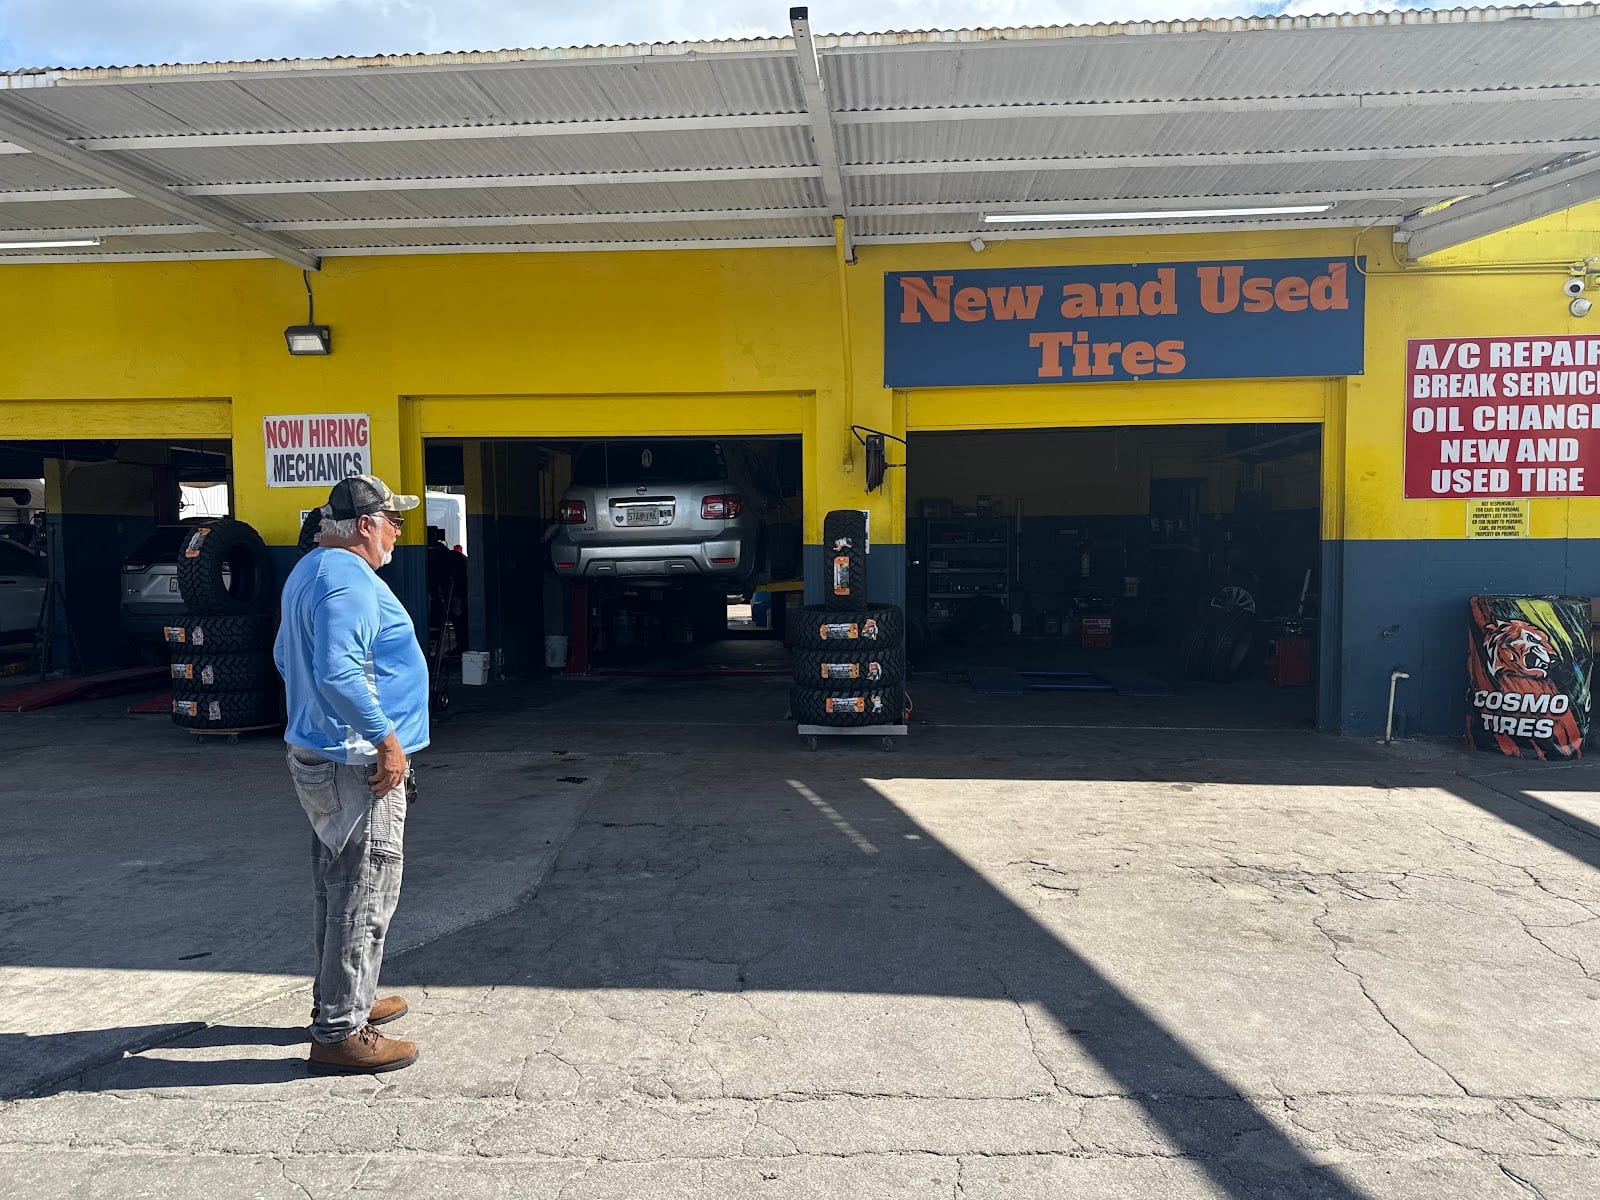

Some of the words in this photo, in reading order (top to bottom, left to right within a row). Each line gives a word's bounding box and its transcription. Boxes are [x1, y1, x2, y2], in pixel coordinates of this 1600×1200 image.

[900, 276, 1043, 323] New
[1061, 268, 1178, 318] and
[1197, 263, 1349, 313] Used
[1029, 331, 1186, 377] Tires
[1416, 343, 1481, 369] A/C
[1413, 373, 1497, 398] BREAK
[1503, 371, 1600, 397] SERVIC
[265, 420, 304, 448] NOW
[309, 418, 368, 447] HIRING
[1412, 407, 1465, 433] OIL
[1440, 439, 1510, 463] NEW
[1516, 438, 1579, 462] AND
[273, 452, 363, 482] MECHANICS
[1431, 468, 1510, 493] USED
[1517, 468, 1585, 492] TIRE
[1473, 690, 1569, 714] COSMO
[1480, 713, 1554, 739] TIRES
